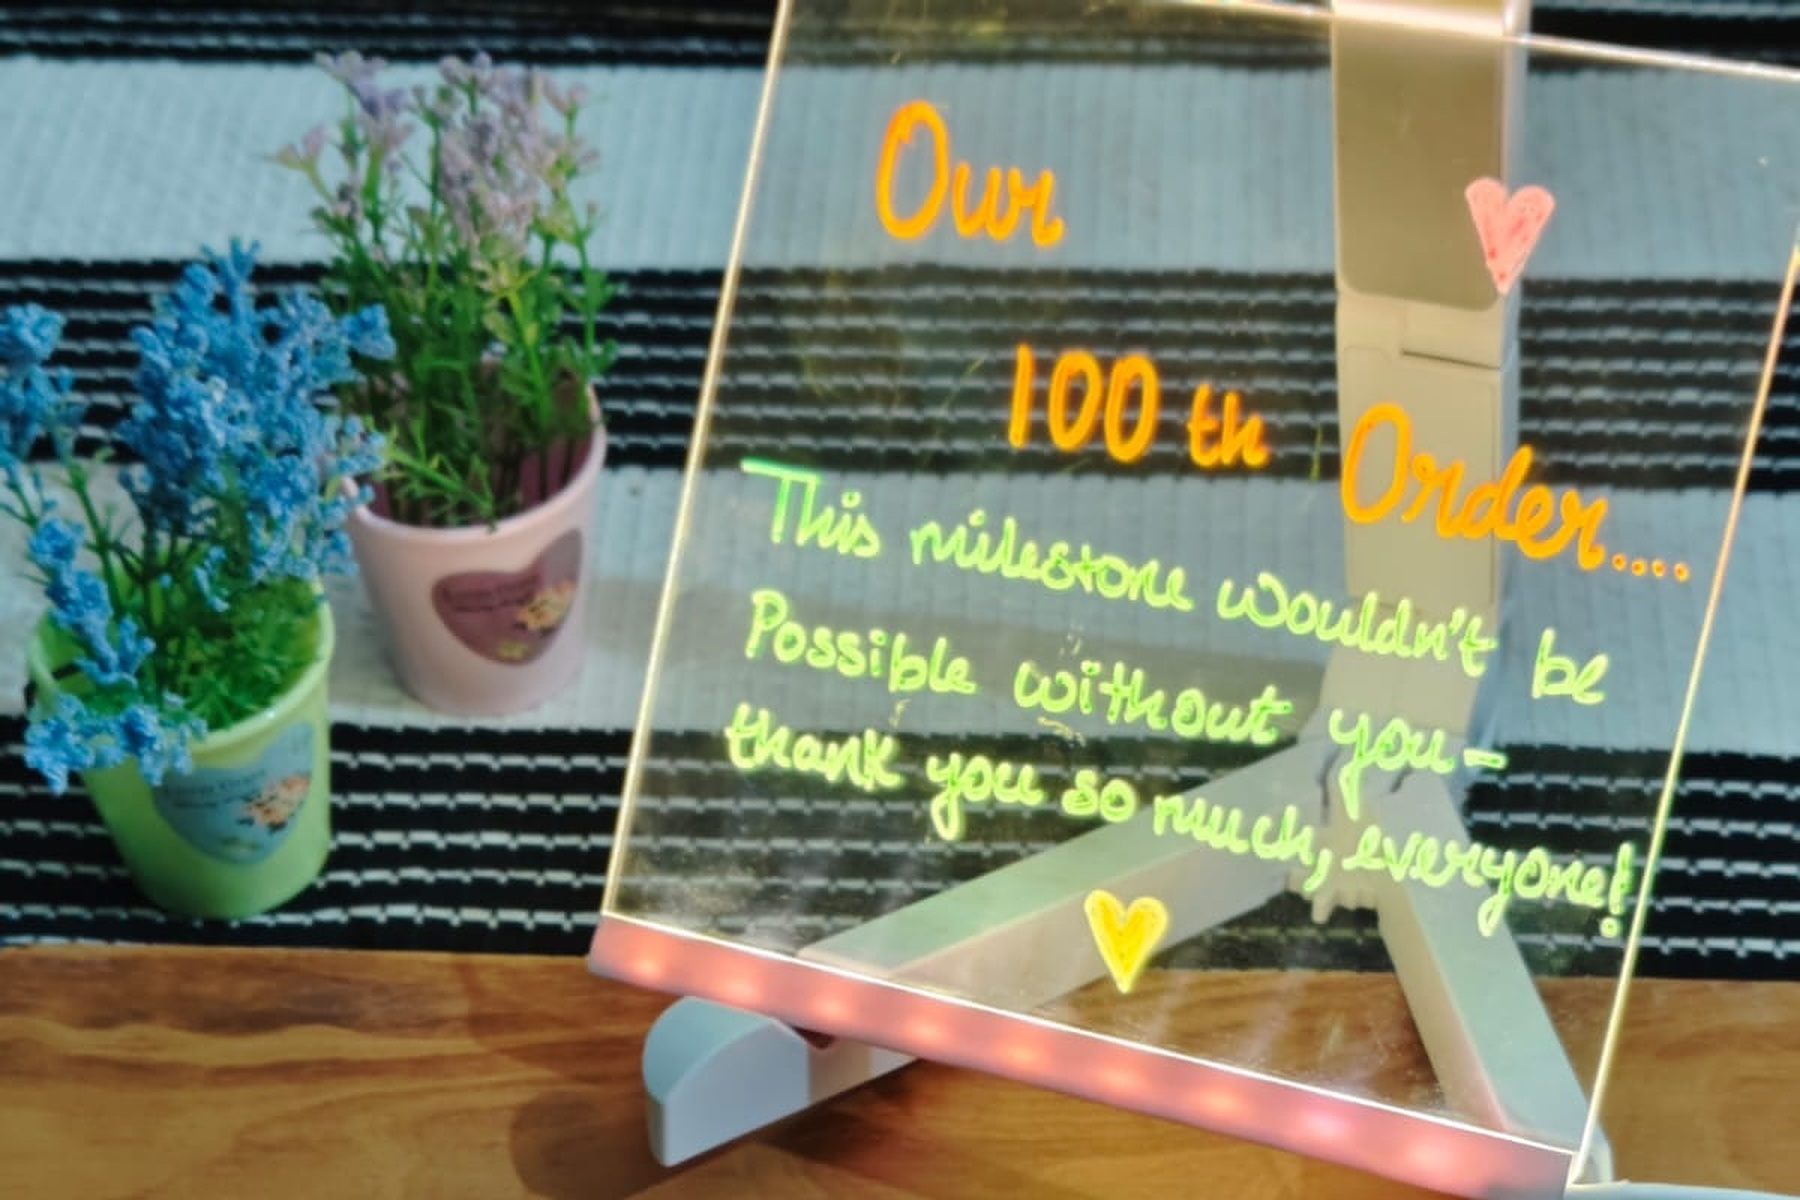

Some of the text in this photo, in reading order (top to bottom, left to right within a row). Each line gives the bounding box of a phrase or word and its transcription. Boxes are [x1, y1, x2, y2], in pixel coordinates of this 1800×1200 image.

[875, 99, 1065, 248] Our
[1008, 343, 1269, 468] 100 th
[740, 457, 1609, 704] This milestone wouldn't be
[745, 589, 977, 695] Possible
[1013, 660, 1293, 745] without
[724, 703, 1637, 938] thank you so much, everyone!
